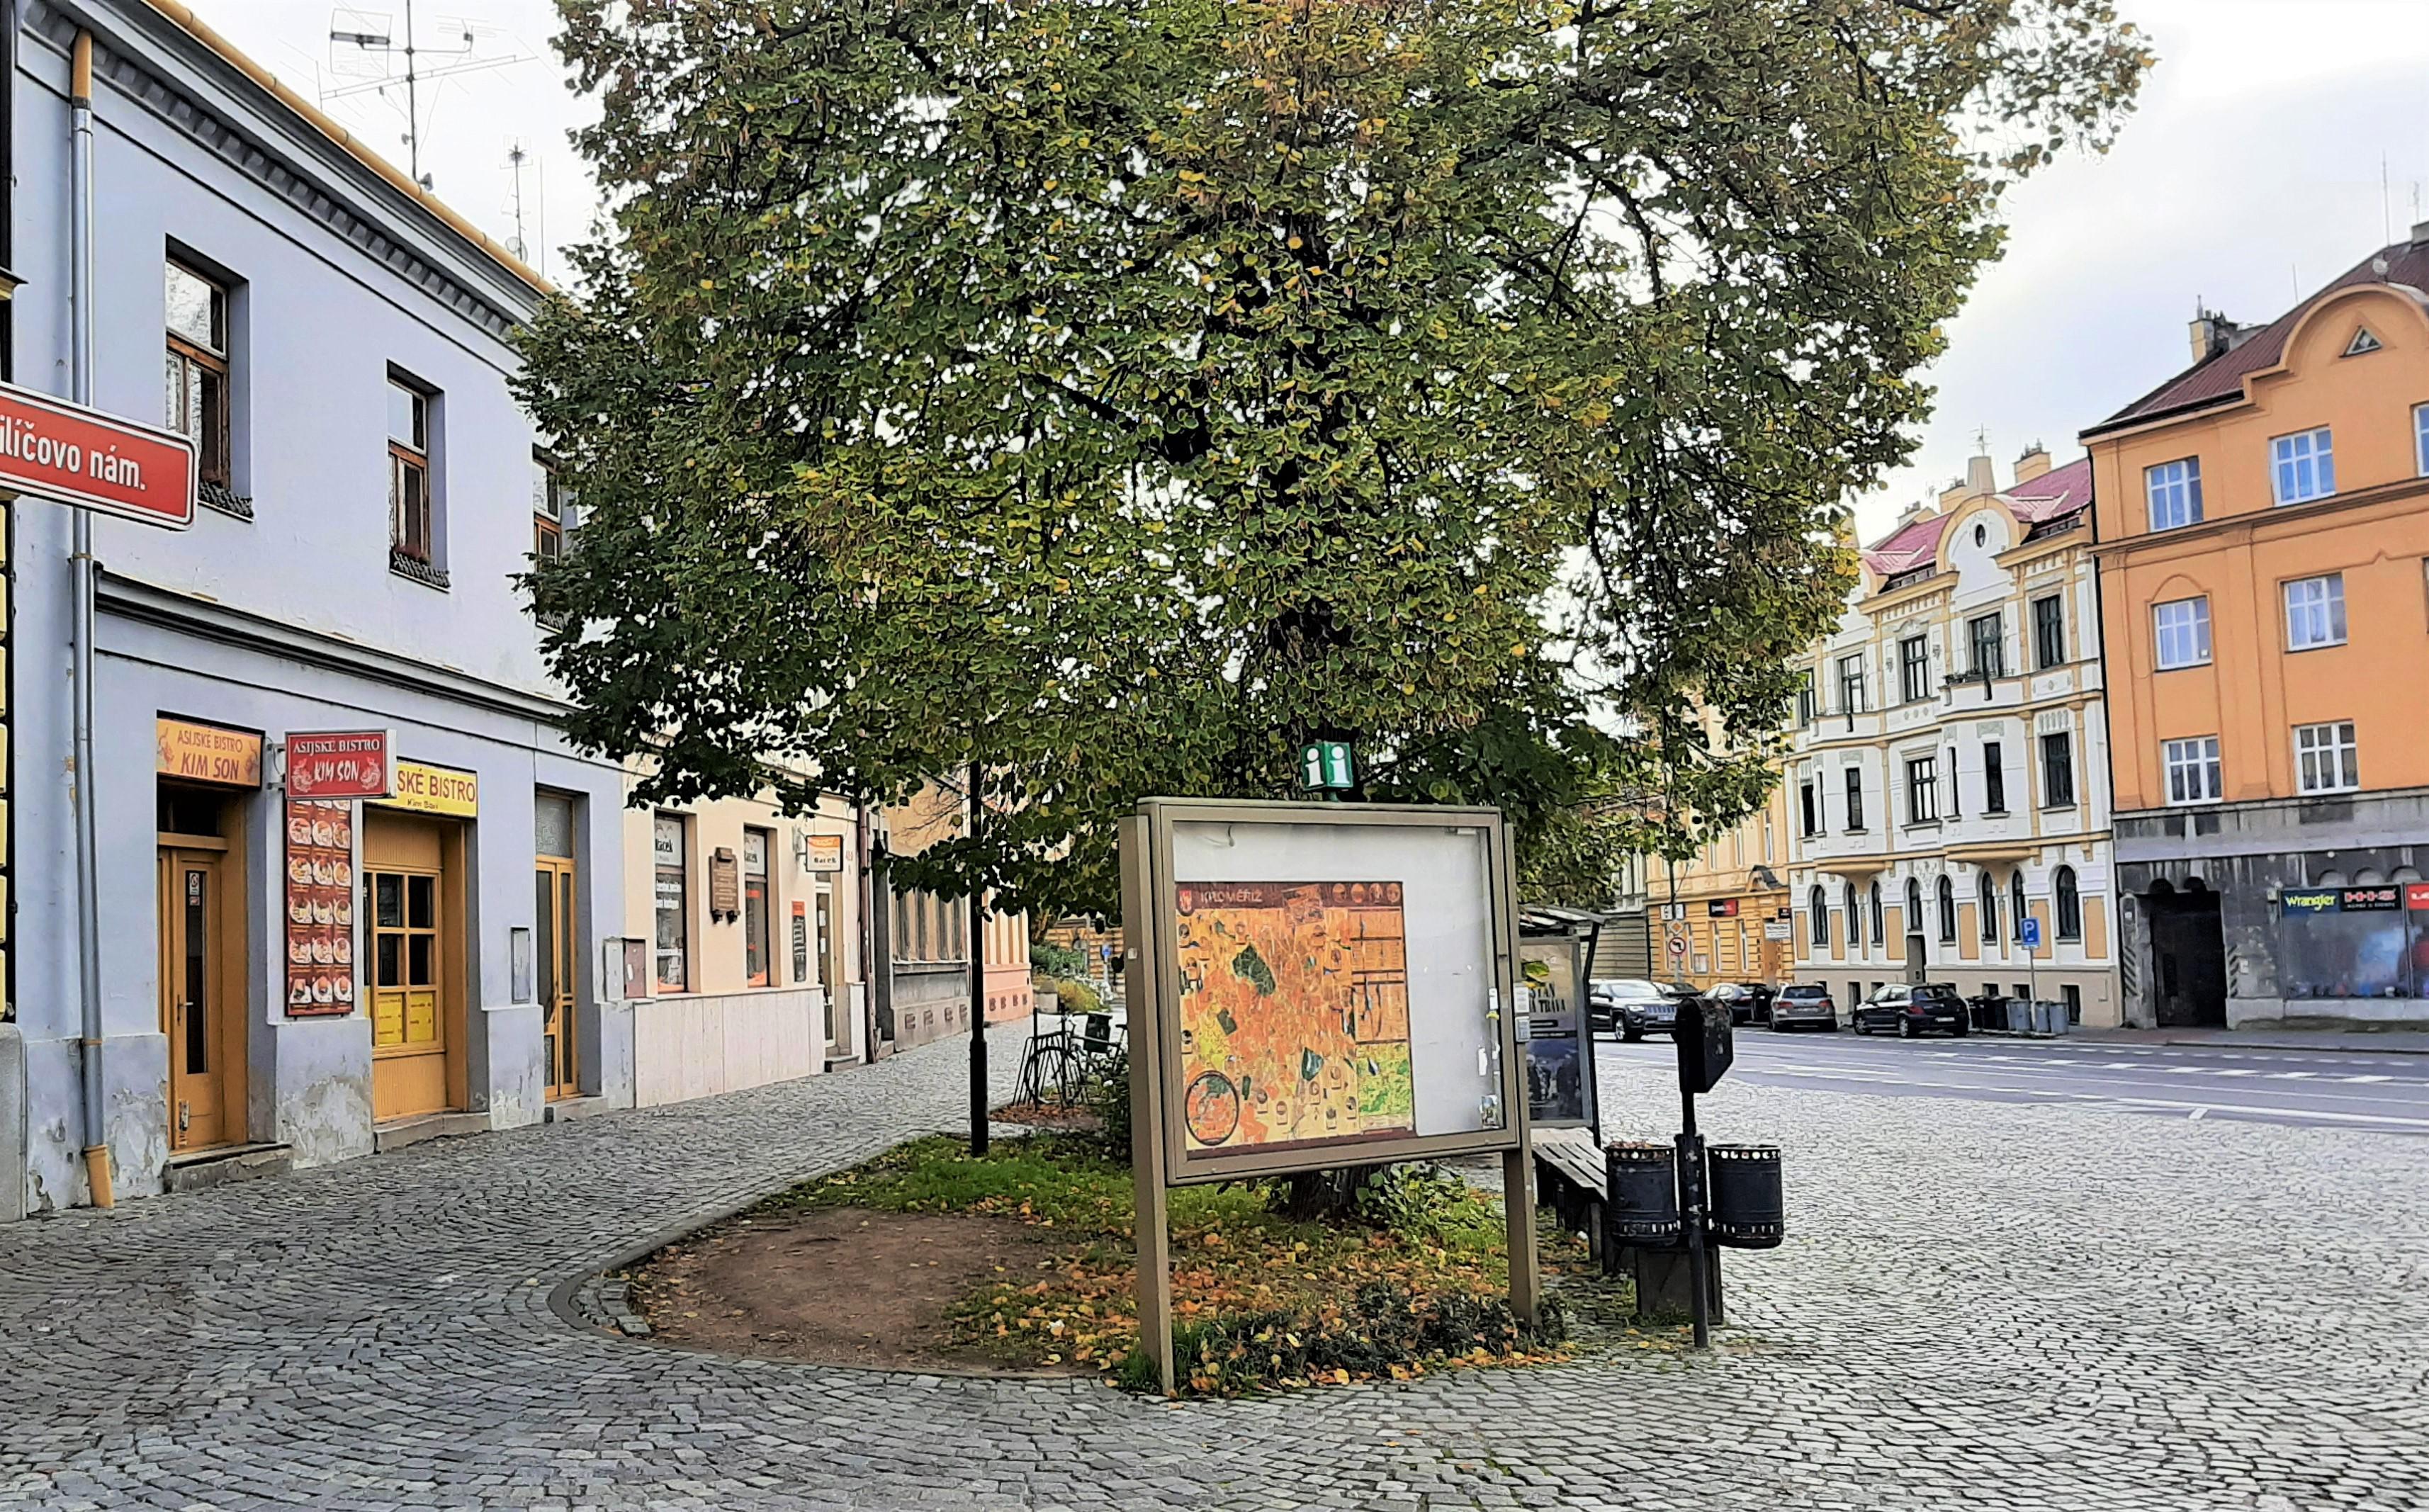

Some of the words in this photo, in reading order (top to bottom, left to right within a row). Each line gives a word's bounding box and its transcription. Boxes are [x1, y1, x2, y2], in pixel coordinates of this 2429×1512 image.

[90, 444, 146, 490] nám.
[214, 735, 242, 752] BISTRO
[294, 737, 336, 757] ASIJSKÉ
[339, 739, 380, 752] BISTRO
[181, 752, 208, 777] KIM
[213, 757, 239, 780] SON
[314, 760, 334, 782] KIM
[337, 760, 359, 782] SON
[429, 775, 475, 802] BISTRO
[2024, 921, 2034, 936] P
